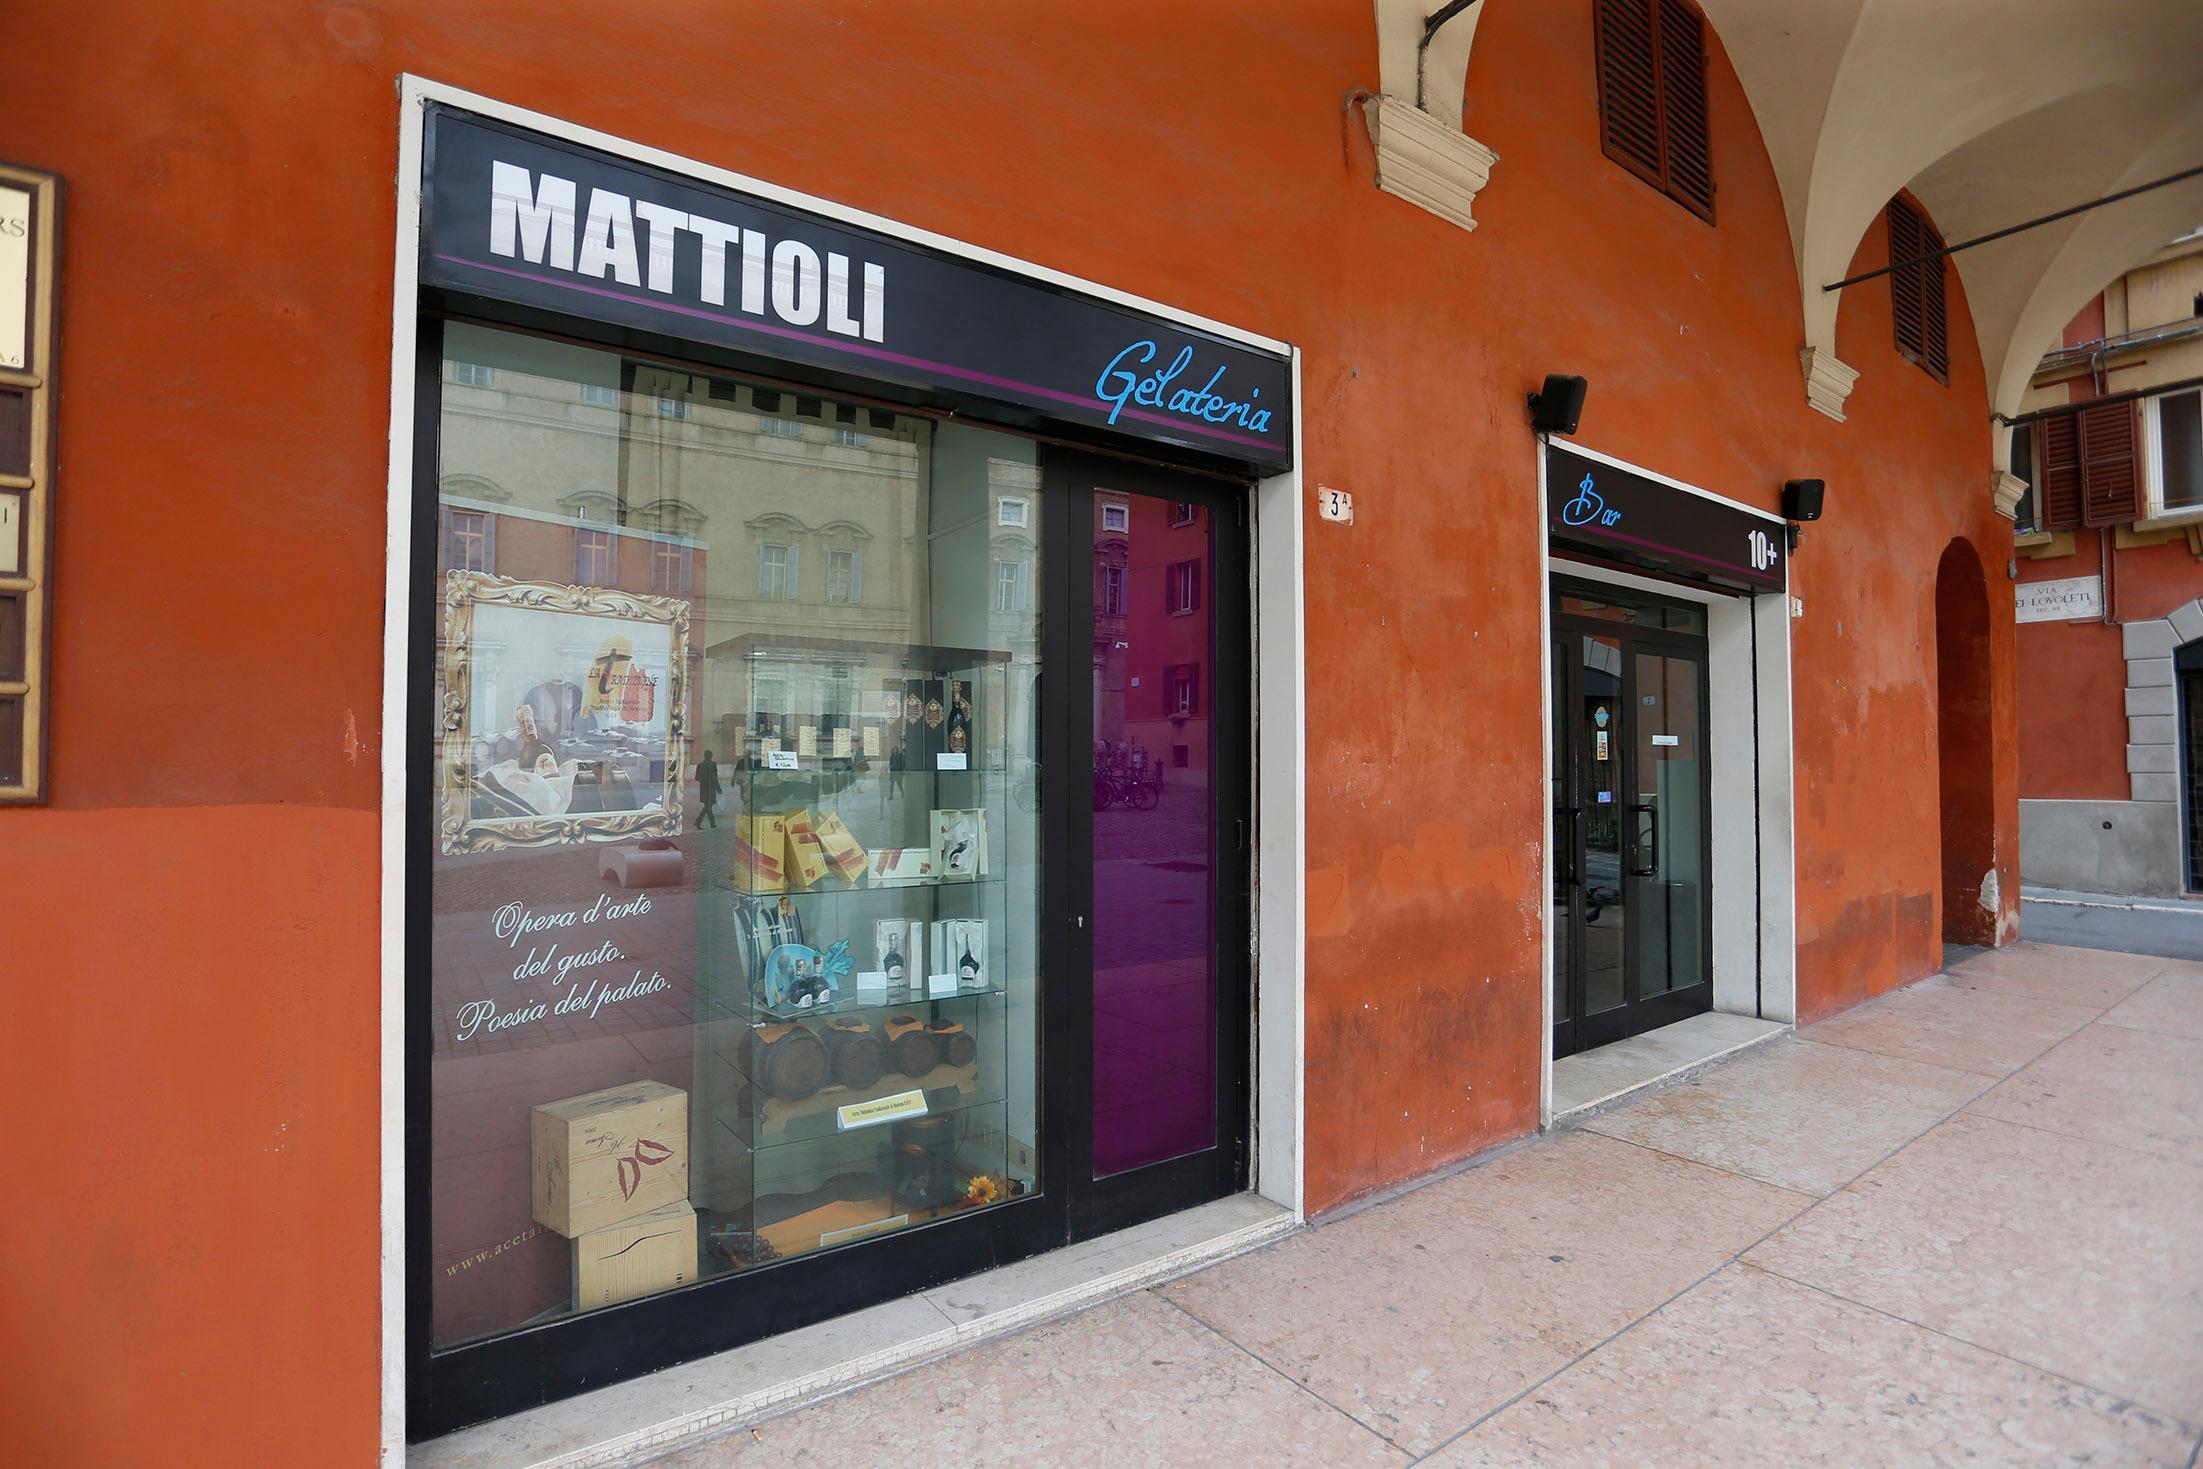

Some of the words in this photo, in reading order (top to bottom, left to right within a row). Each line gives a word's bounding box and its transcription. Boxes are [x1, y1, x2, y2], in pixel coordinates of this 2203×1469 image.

[490, 160, 885, 344] MATTIOLI
[1095, 340, 1272, 433] Gelateria
[1562, 473, 1622, 527] Bar
[1748, 530, 1777, 571] 10+
[492, 900, 577, 948] Opera
[583, 893, 652, 924] d'arte
[513, 944, 558, 980] del
[553, 941, 626, 986] gusto.
[456, 998, 549, 1041] Poesia
[554, 980, 598, 1016] del
[589, 970, 672, 1019] palato.
